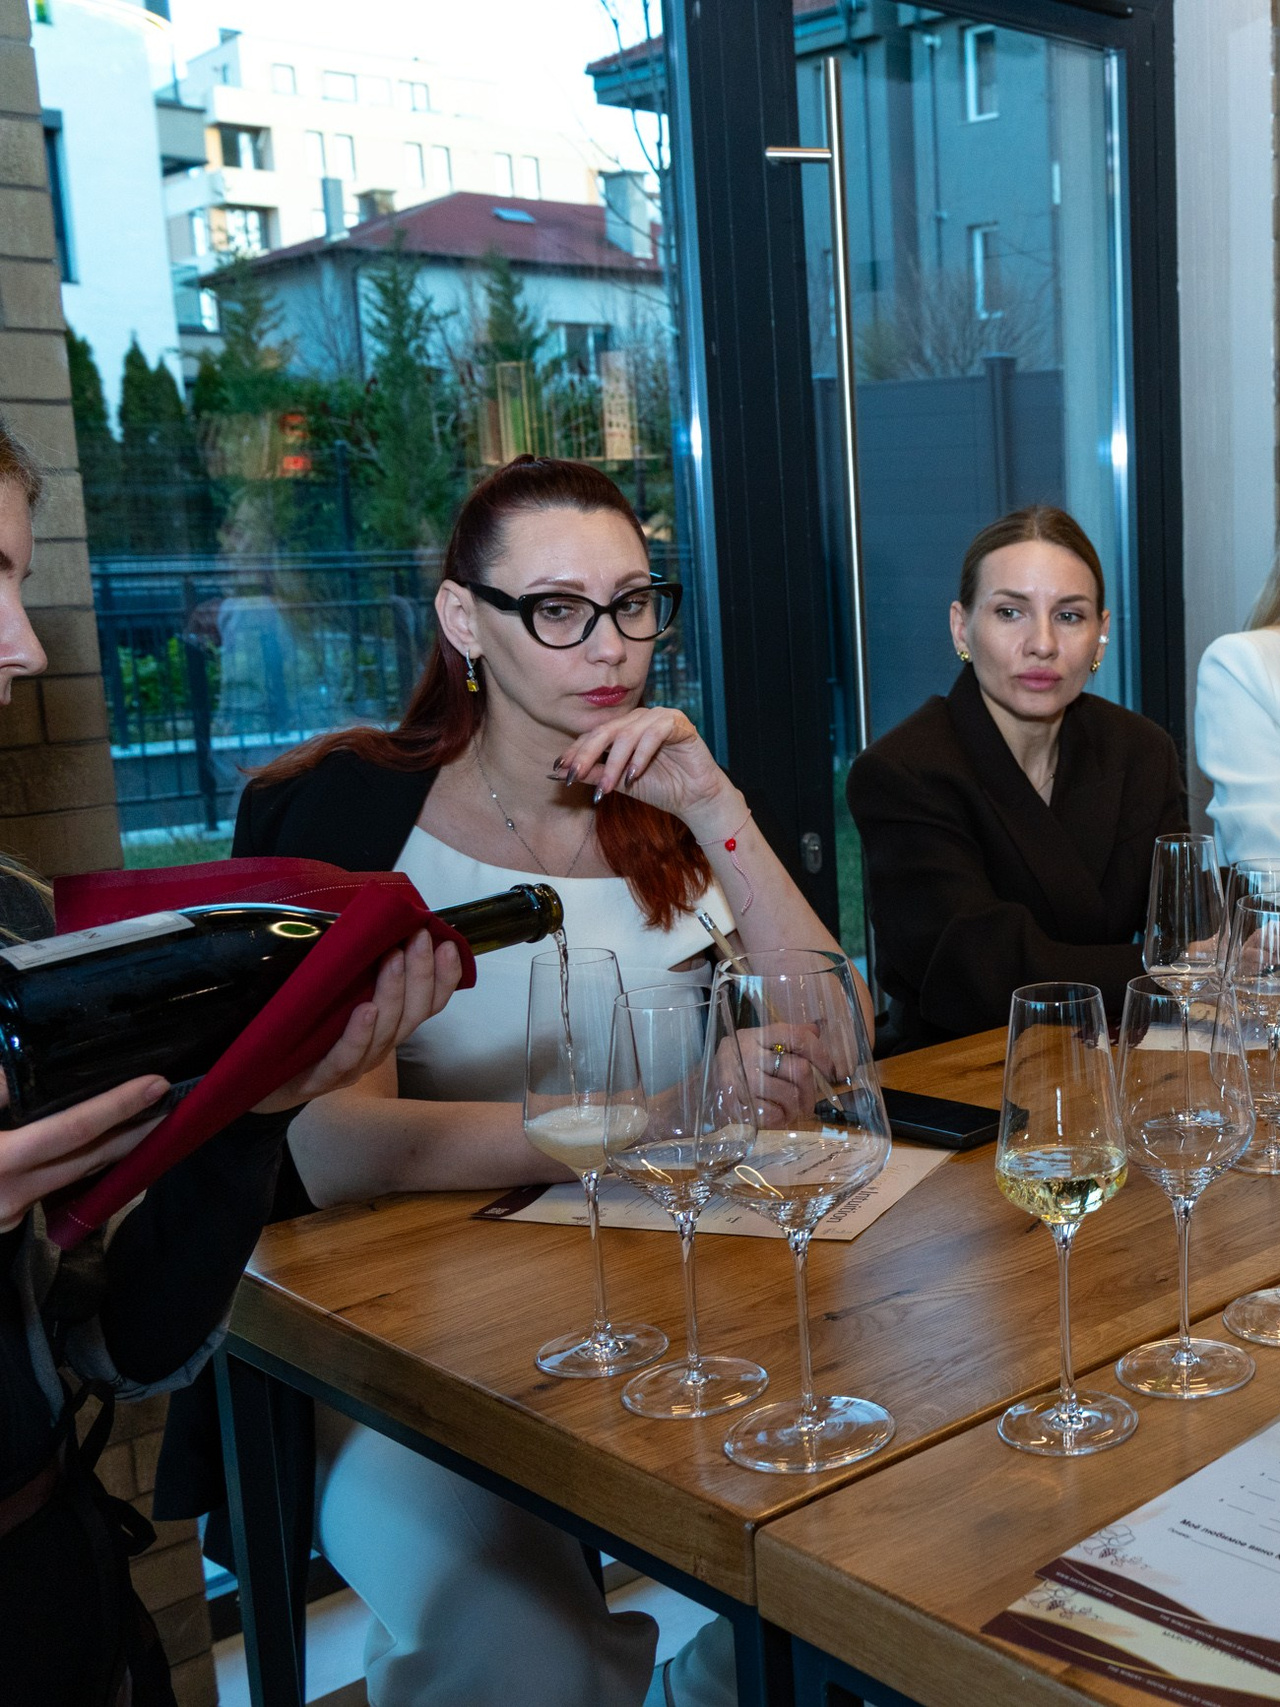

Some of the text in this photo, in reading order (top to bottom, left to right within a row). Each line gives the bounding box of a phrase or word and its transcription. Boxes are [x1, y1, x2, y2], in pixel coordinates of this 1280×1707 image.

[826, 1190, 879, 1223] Intuition
[1180, 1518, 1201, 1530] Моё
[1201, 1528, 1247, 1548] любимое
[1248, 1544, 1274, 1558] вино
